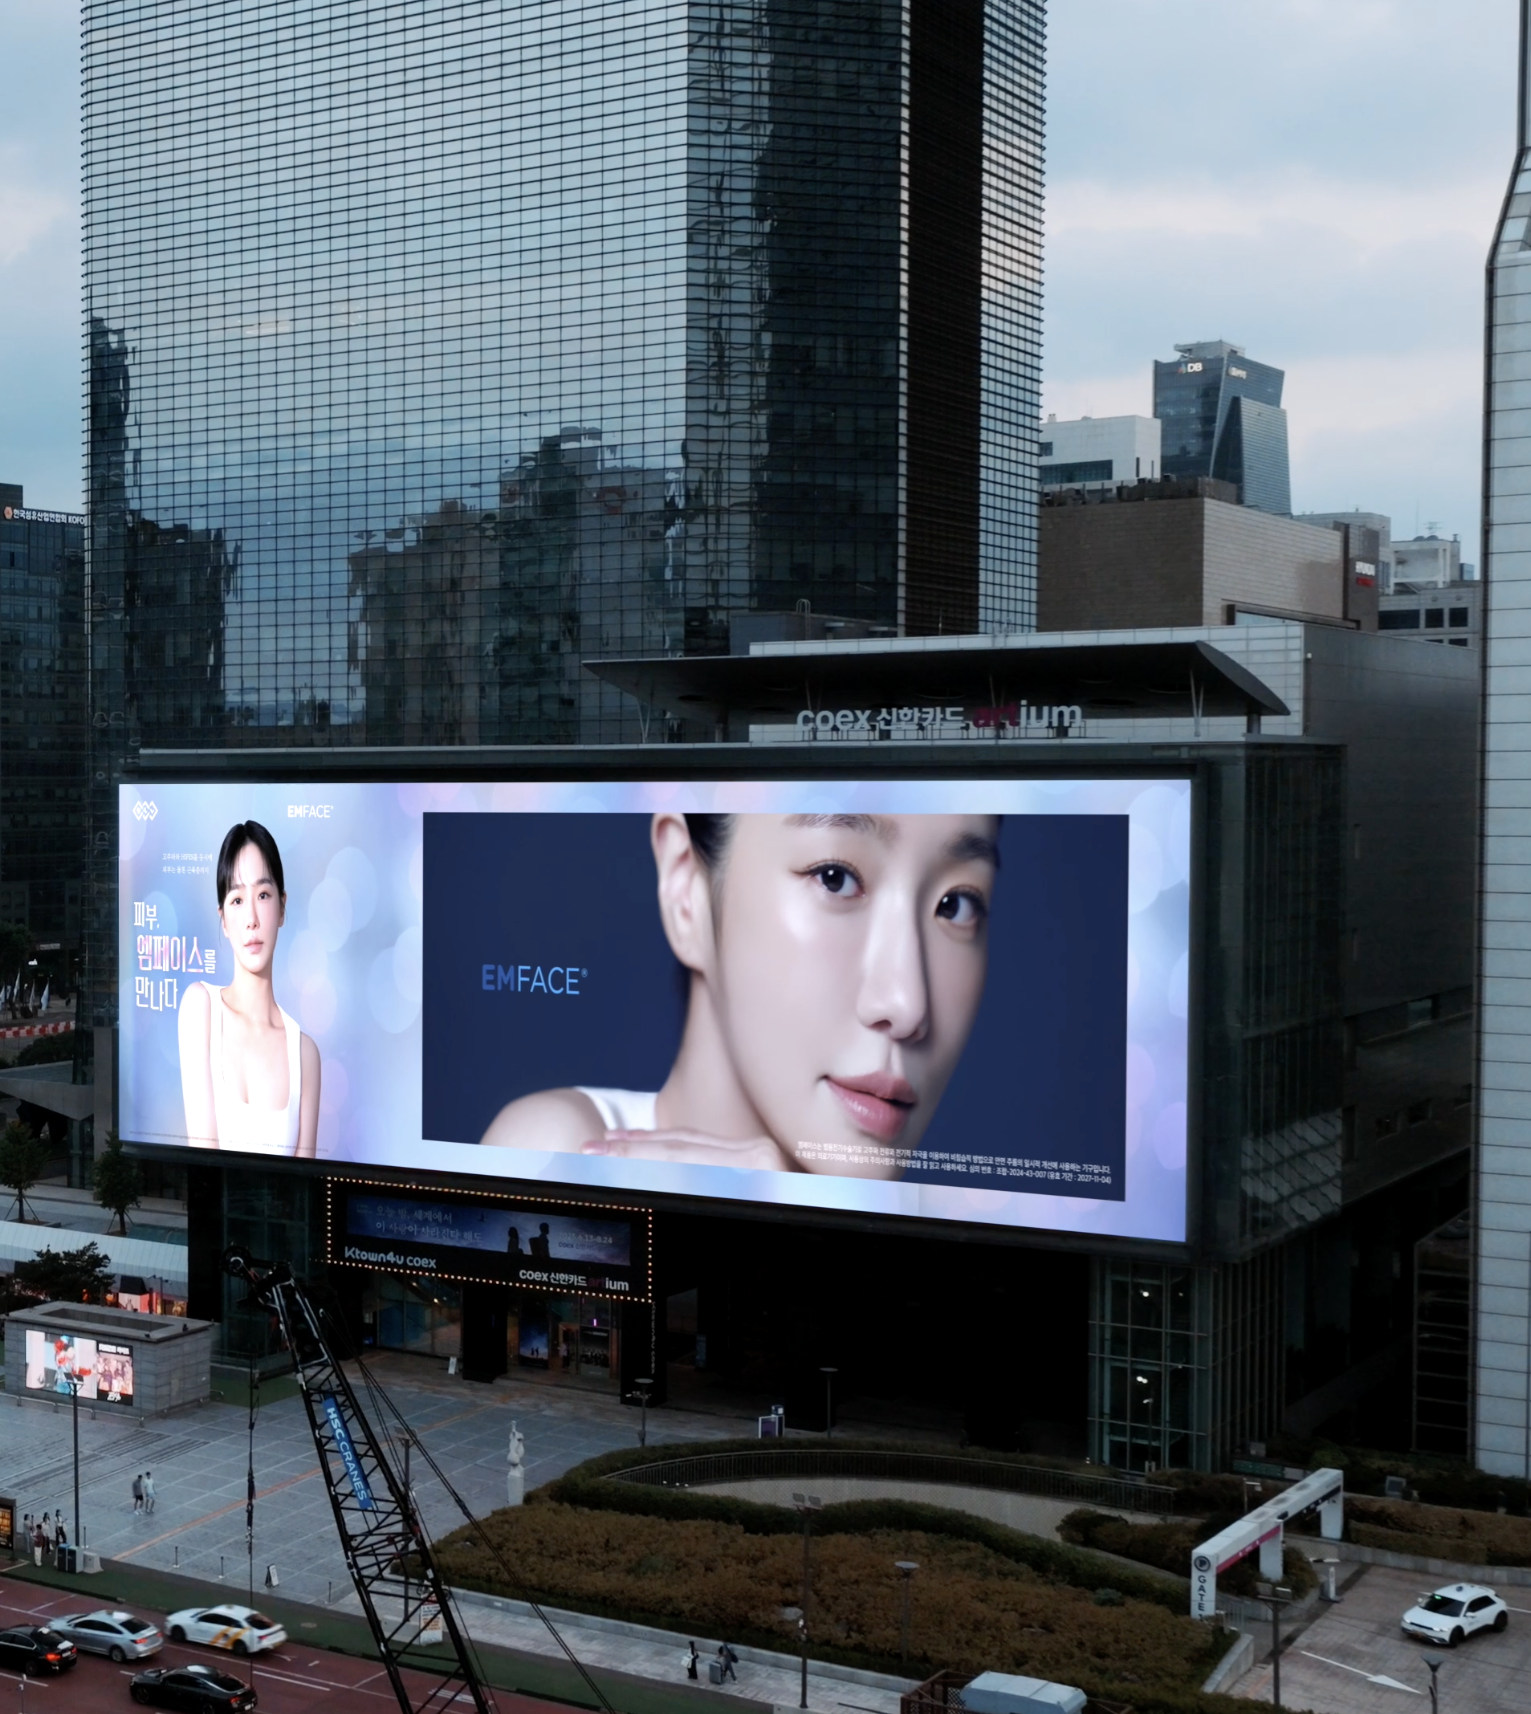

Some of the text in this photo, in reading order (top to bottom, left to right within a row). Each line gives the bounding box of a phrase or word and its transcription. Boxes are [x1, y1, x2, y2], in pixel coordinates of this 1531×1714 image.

[1187, 362, 1203, 373] DB
[13, 508, 67, 523] 한국섬유산업연합회
[796, 699, 1082, 730] coex 신한카드 artium
[136, 934, 217, 974] 엠페이스를
[135, 976, 178, 1012] 만나다
[912, 1150, 927, 1159] 자극을
[928, 1151, 949, 1161] 이용하여
[972, 1154, 993, 1164] 방법으로
[1007, 1157, 1023, 1167] 주름의
[1024, 1159, 1040, 1168] 일시적
[1041, 1160, 1058, 1170] 개선에
[1059, 1162, 1081, 1172] 사용하는
[929, 1161, 940, 1170] 읽고
[981, 1165, 992, 1174] 번호
[1061, 1172, 1073, 1181] 기간
[375, 1205, 395, 1218] 오늘
[413, 1209, 452, 1225] 세계에서
[375, 1221, 484, 1243] 이 사랑이 사라진다 해도
[344, 1246, 437, 1269] Ktown4u coex
[519, 1269, 629, 1292] coex 신한카드 artium
[326, 1407, 368, 1501] HSC CRANES
[1197, 1575, 1207, 1611] GATE
